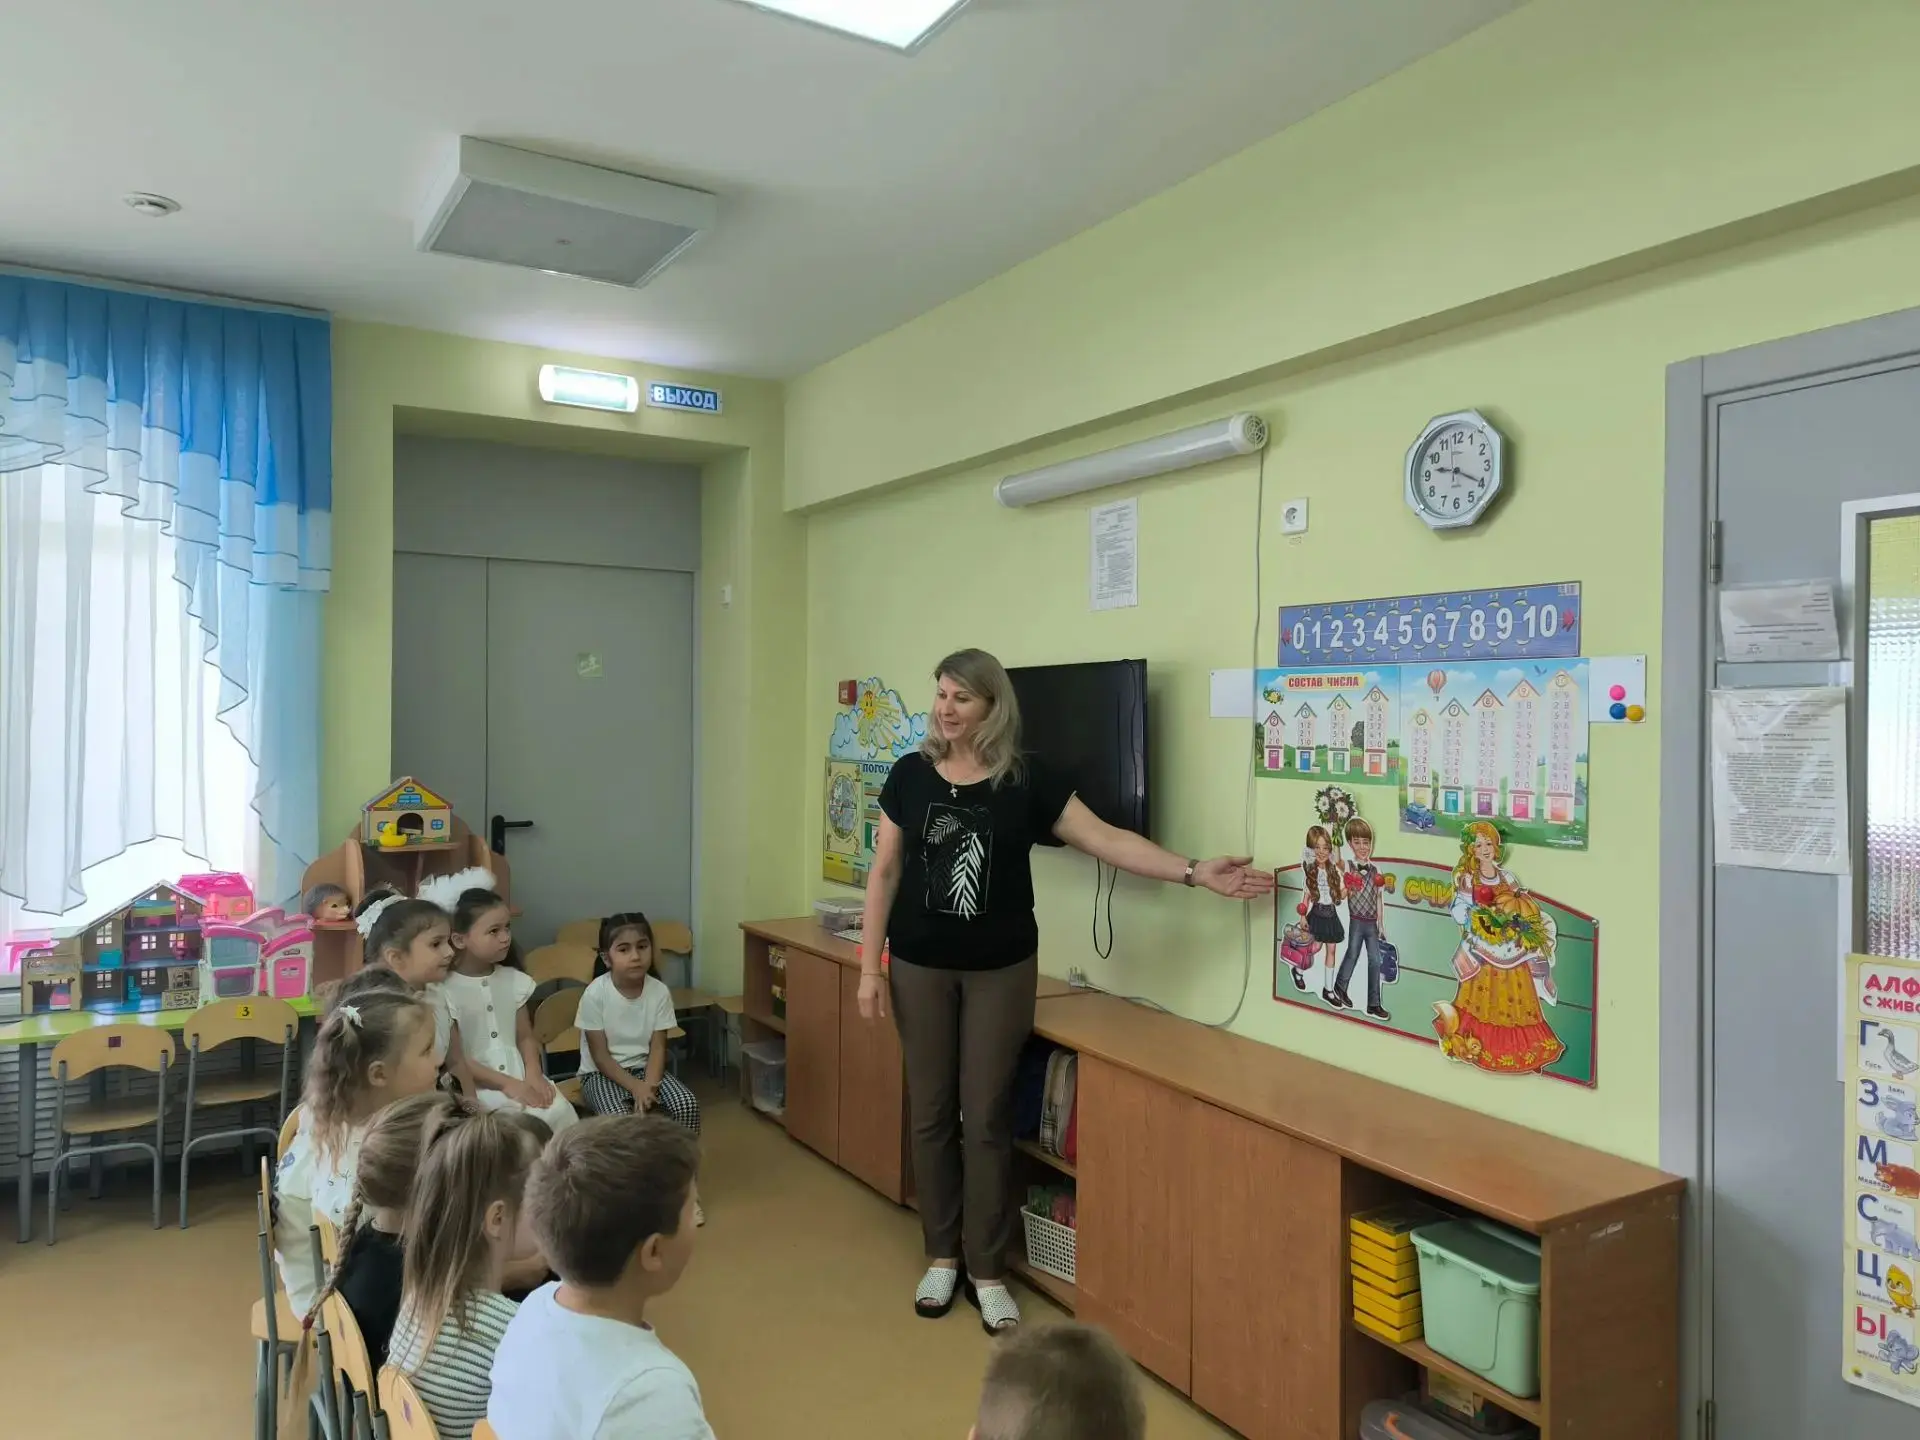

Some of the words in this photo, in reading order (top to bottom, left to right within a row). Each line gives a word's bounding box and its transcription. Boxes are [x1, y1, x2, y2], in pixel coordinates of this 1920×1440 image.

[653, 386, 715, 410] ВЫХОД
[1440, 438, 1449, 451] 11
[1452, 432, 1464, 445] 12
[1468, 433, 1474, 445] 1
[1478, 443, 1486, 456] 2
[1429, 452, 1440, 464] 10
[1483, 459, 1491, 472] 3
[1424, 470, 1431, 482] 9
[1478, 477, 1485, 489] 4
[1429, 486, 1436, 498] 8
[1467, 491, 1475, 503] 5
[1440, 495, 1447, 507] 7
[1453, 497, 1460, 509] 6
[1293, 622, 1305, 650] 0
[1312, 621, 1321, 649] 1
[1330, 619, 1344, 648] 2
[1351, 618, 1366, 647] 3
[1373, 616, 1388, 645] 4
[1398, 614, 1413, 645] 5
[1422, 612, 1436, 644] 6
[1445, 610, 1461, 642] 7
[1470, 609, 1486, 641] 8
[1495, 607, 1513, 640] 9
[1522, 604, 1558, 638] 10
[1288, 677, 1323, 688] СОСТАВ
[1327, 676, 1359, 687] ЧИСЛА
[1865, 974, 1920, 998] АЛФ
[1863, 995, 1872, 1006] С
[242, 1006, 250, 1016] 3
[1860, 1020, 1879, 1045] Г
[1859, 1079, 1879, 1106] З
[1858, 1135, 1887, 1166] М
[1858, 1194, 1879, 1221] С
[1857, 1248, 1882, 1287] Ц
[1857, 1306, 1886, 1340] Ы
